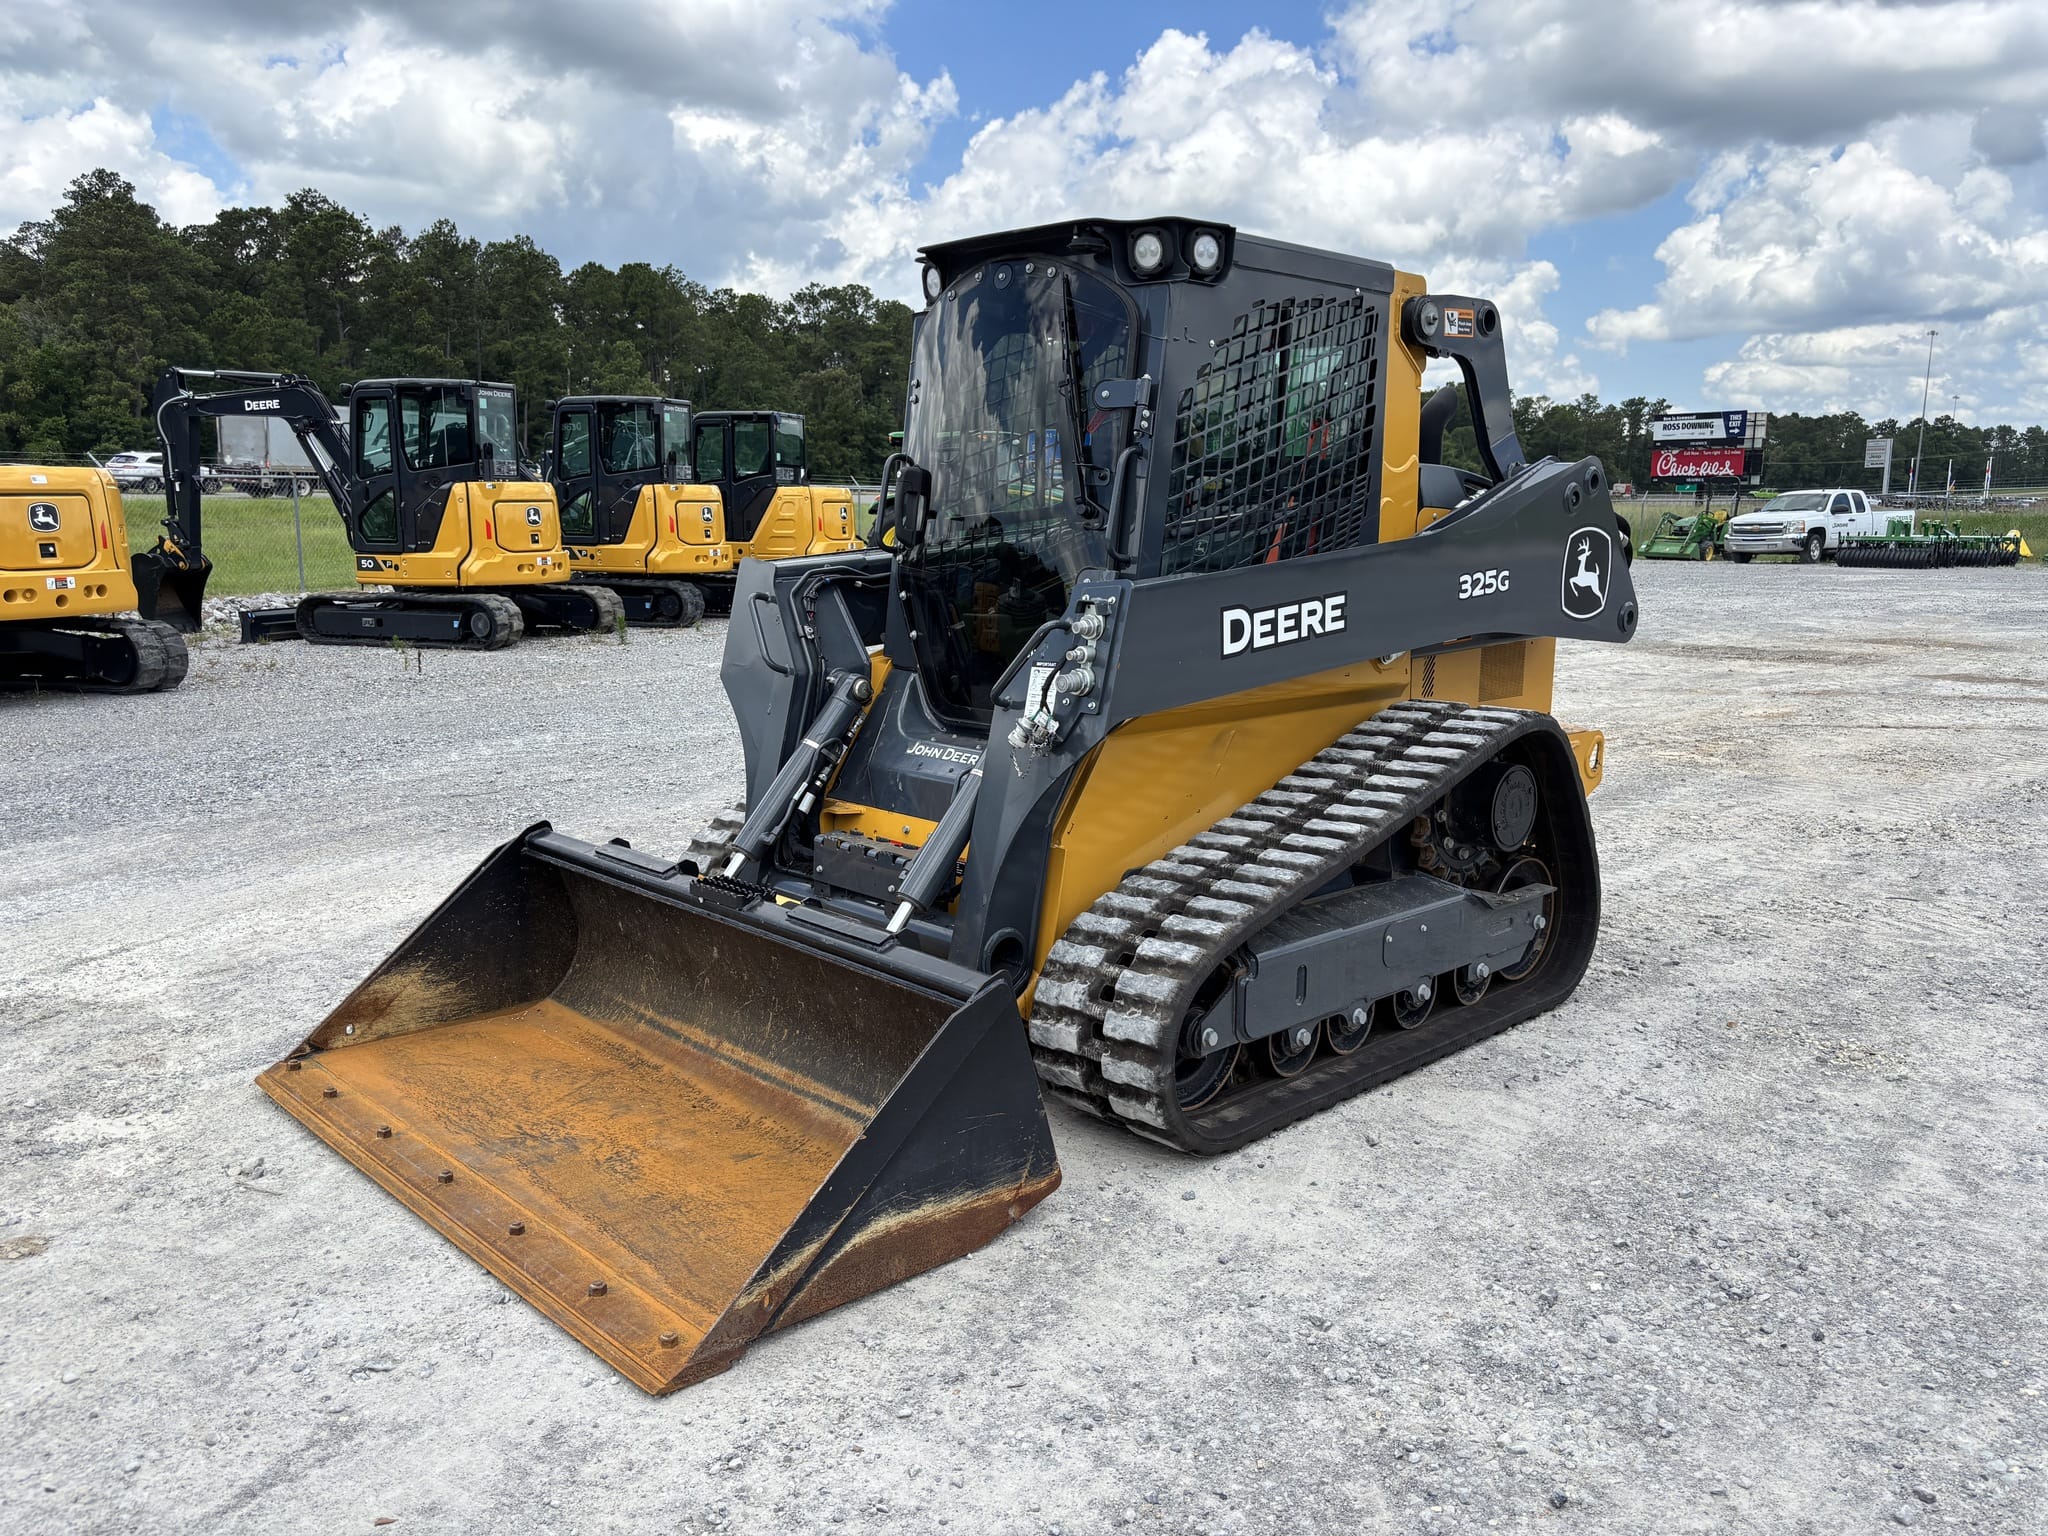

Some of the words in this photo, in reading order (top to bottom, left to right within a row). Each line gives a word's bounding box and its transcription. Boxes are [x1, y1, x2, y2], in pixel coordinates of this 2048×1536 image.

[478, 389, 493, 397] JOHN
[494, 390, 512, 399] DEERE
[244, 399, 281, 411] DEERE
[1663, 423, 1680, 431] ROSS
[1681, 421, 1714, 430] DOWNING
[361, 559, 374, 568] 50
[386, 560, 393, 568] P
[1458, 569, 1510, 600] 325G
[1222, 594, 1346, 656] DEERE
[906, 741, 943, 759] JOHN
[942, 747, 980, 766] DEER
